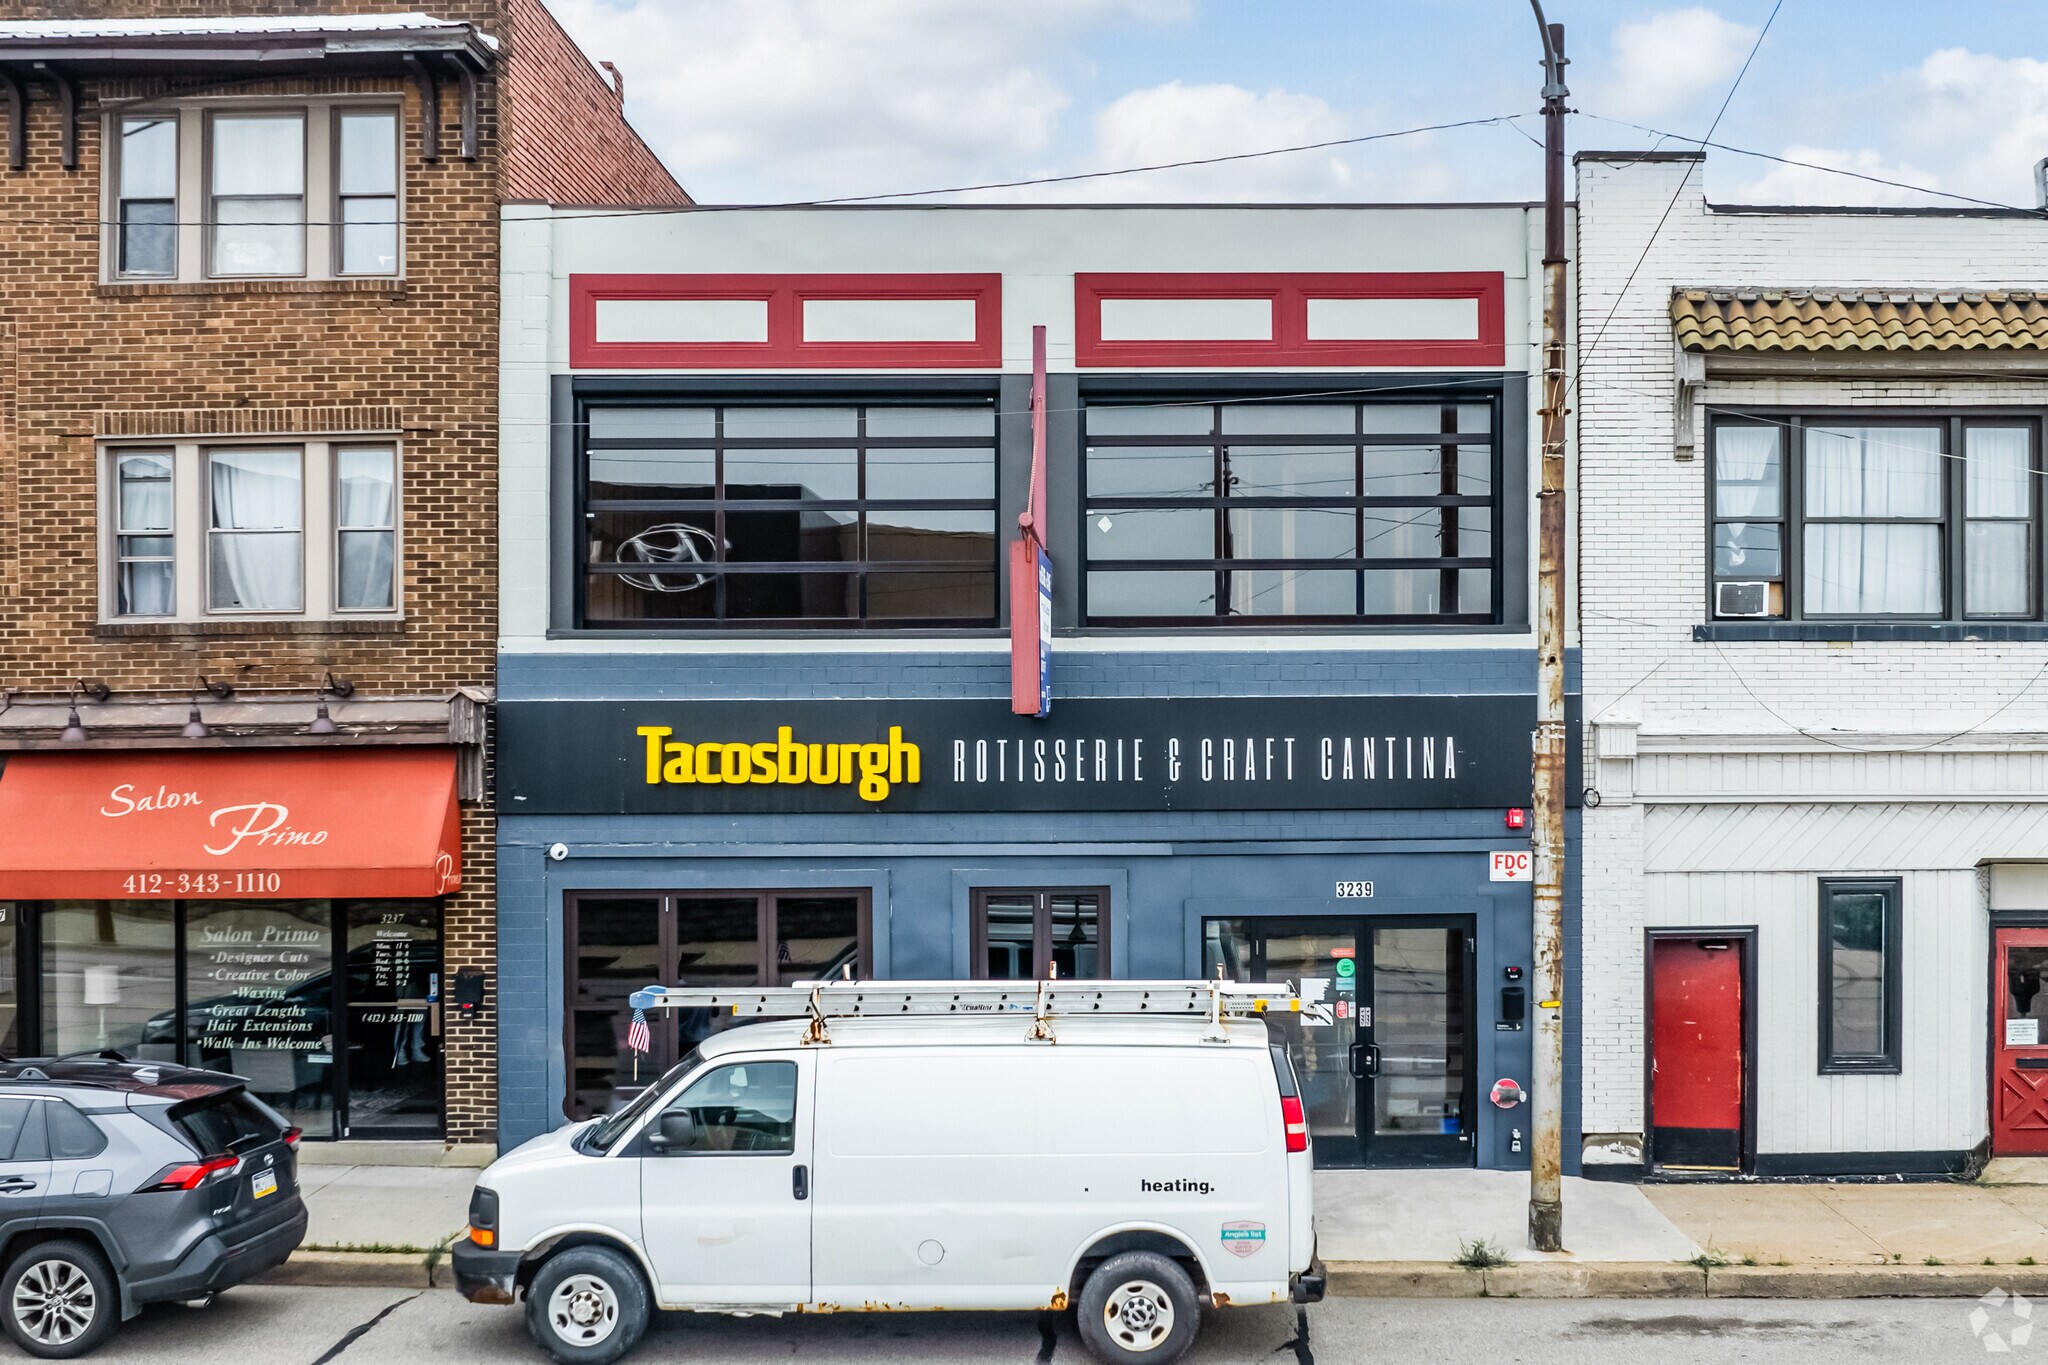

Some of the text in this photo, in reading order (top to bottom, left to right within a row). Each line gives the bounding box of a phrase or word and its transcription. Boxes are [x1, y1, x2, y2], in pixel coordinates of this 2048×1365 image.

[637, 726, 920, 801] Tacosburgh
[954, 737, 1456, 782] ROTISSERIE & CRAFT CANTINA
[101, 784, 203, 817] Salon
[203, 801, 328, 855] Primo
[1494, 854, 1528, 870] FDC
[122, 872, 281, 894] 412-343-1110
[1337, 882, 1372, 897] 3239
[381, 913, 405, 924] 3237
[201, 925, 320, 943] Salon Primo
[216, 951, 310, 965] Designer Cuts
[215, 968, 311, 981] Creative Color
[238, 986, 286, 1000] Waxing
[212, 1004, 307, 1018] Great Lengths
[361, 1013, 424, 1023] (412) 343-1110
[206, 1019, 313, 1031] Hair Extensions
[203, 1037, 322, 1049] Walk Ins Welcome
[1141, 1179, 1215, 1194] heating.
